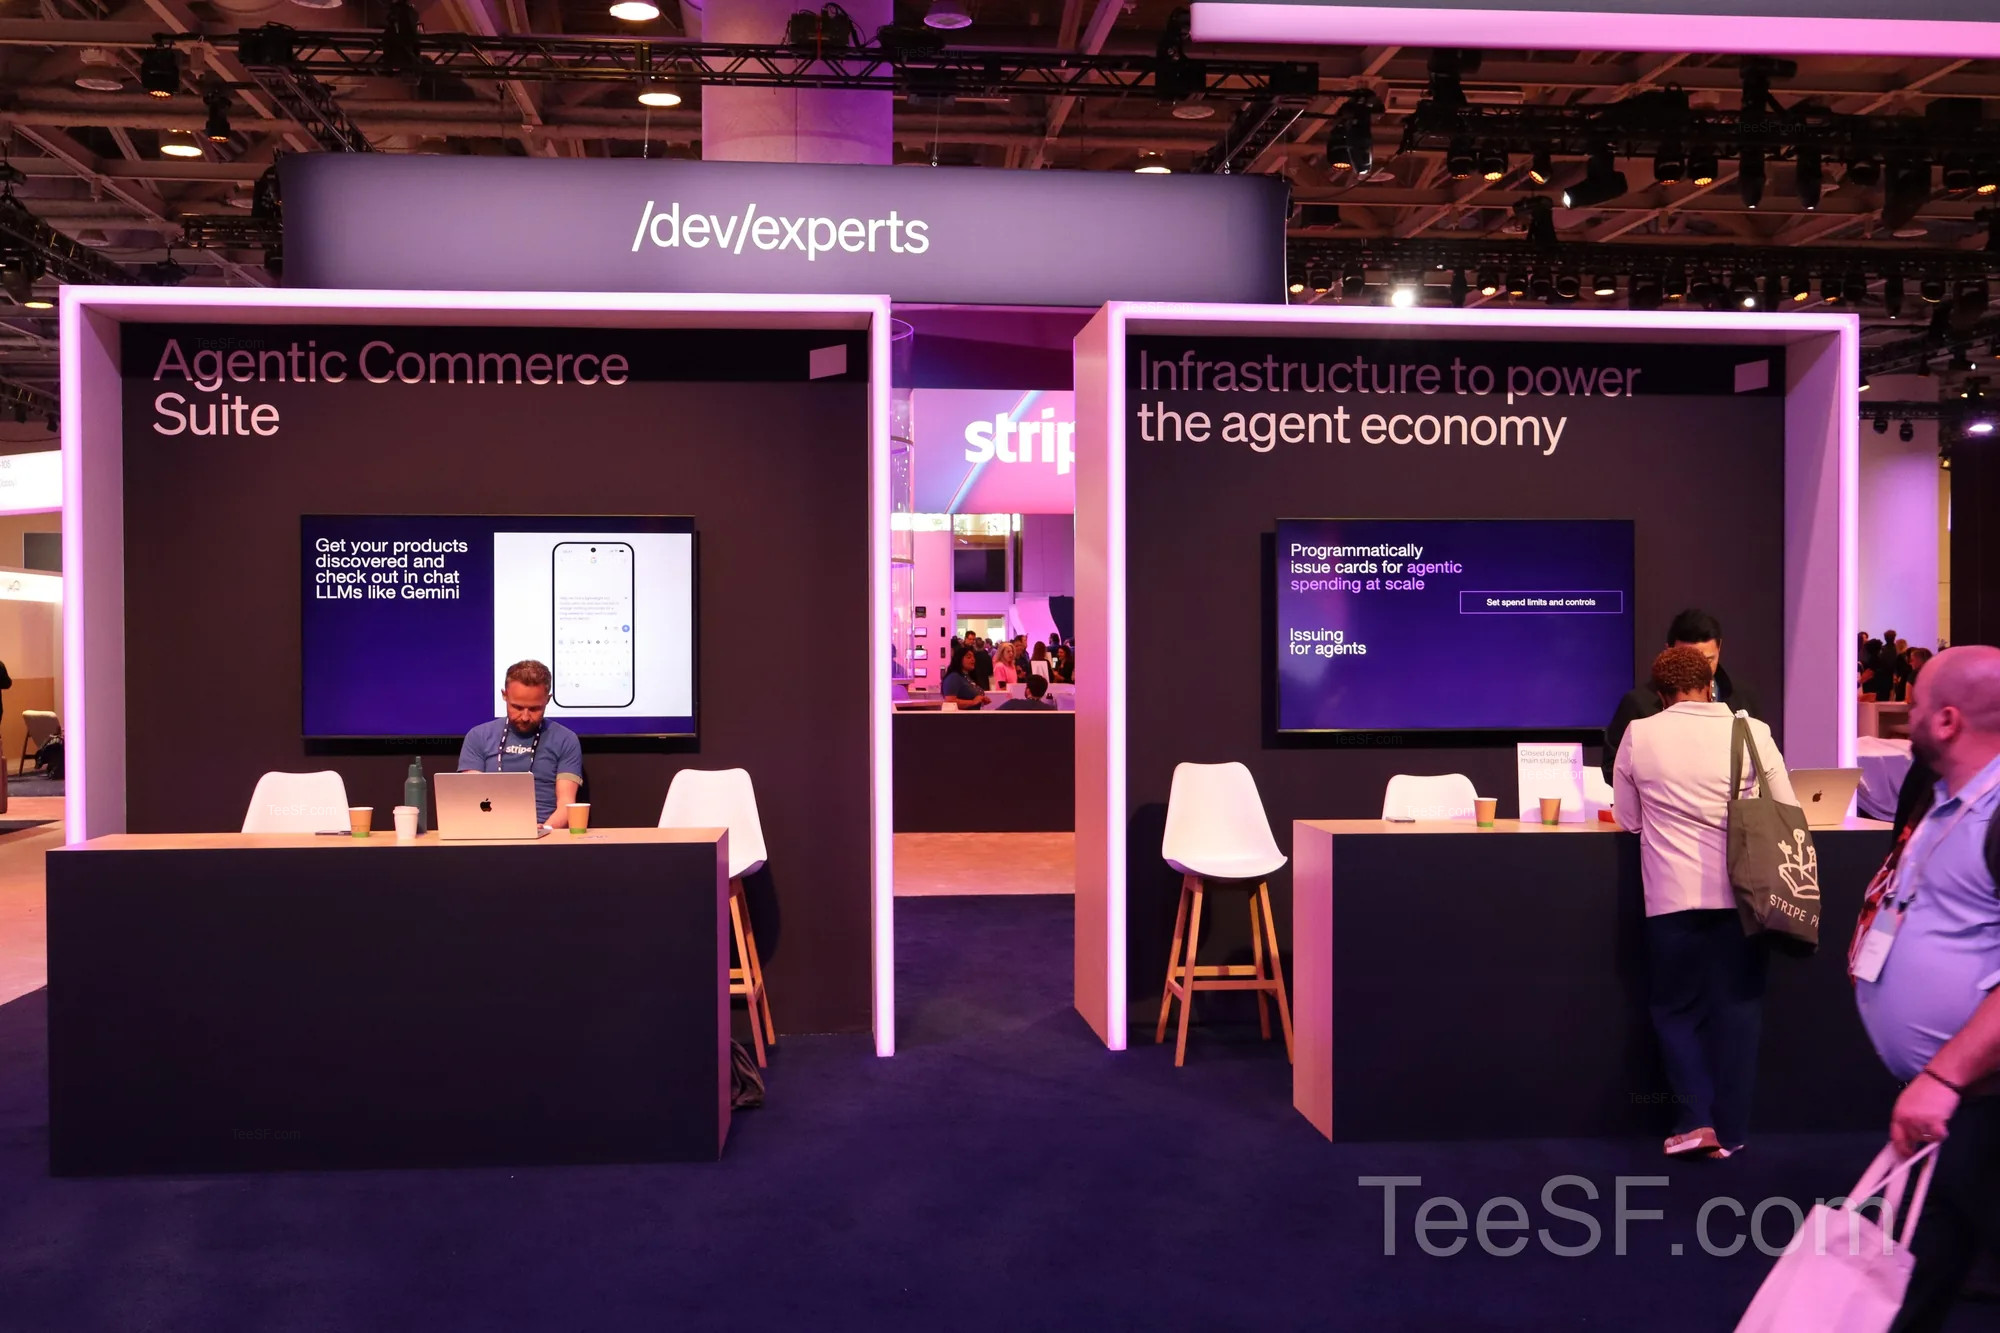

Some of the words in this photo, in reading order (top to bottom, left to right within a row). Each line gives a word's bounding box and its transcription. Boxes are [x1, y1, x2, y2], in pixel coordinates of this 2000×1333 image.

[632, 200, 930, 261] /dev/experts
[153, 338, 347, 392] Agentic
[359, 340, 629, 386] Commerce
[1140, 350, 1442, 396] Infrastructure
[1450, 356, 1495, 396] to
[1507, 365, 1642, 405] power
[153, 391, 280, 436] Suite
[1137, 402, 1211, 443] the
[1222, 406, 1351, 453] agent
[1361, 415, 1567, 456] economy
[315, 538, 347, 552] Get
[351, 541, 389, 556] your
[393, 539, 468, 556] products
[1290, 543, 1423, 560] Programmatically
[315, 554, 408, 568] discovered
[413, 554, 445, 568] and
[1290, 561, 1331, 574] issue
[1334, 561, 1378, 574] cards
[1381, 560, 1404, 574] for
[1406, 560, 1463, 577] agentic
[315, 570, 367, 584] check
[371, 570, 399, 584] out
[403, 570, 418, 584] in
[423, 570, 460, 584] chat
[1290, 577, 1362, 594] spending
[1365, 578, 1381, 591] at
[1385, 577, 1425, 591] scale
[316, 585, 363, 600] LLMs
[367, 585, 397, 600] like
[400, 585, 460, 600] Gemini
[1486, 598, 1500, 607] Set
[1501, 598, 1526, 608] spend
[1527, 598, 1548, 607] limits
[1548, 598, 1564, 607] and
[1565, 598, 1596, 607] controls
[1289, 627, 1344, 644] Issuing
[1289, 641, 1311, 655] for
[1315, 641, 1367, 658] agents
[1769, 894, 1807, 922] STRIPE
